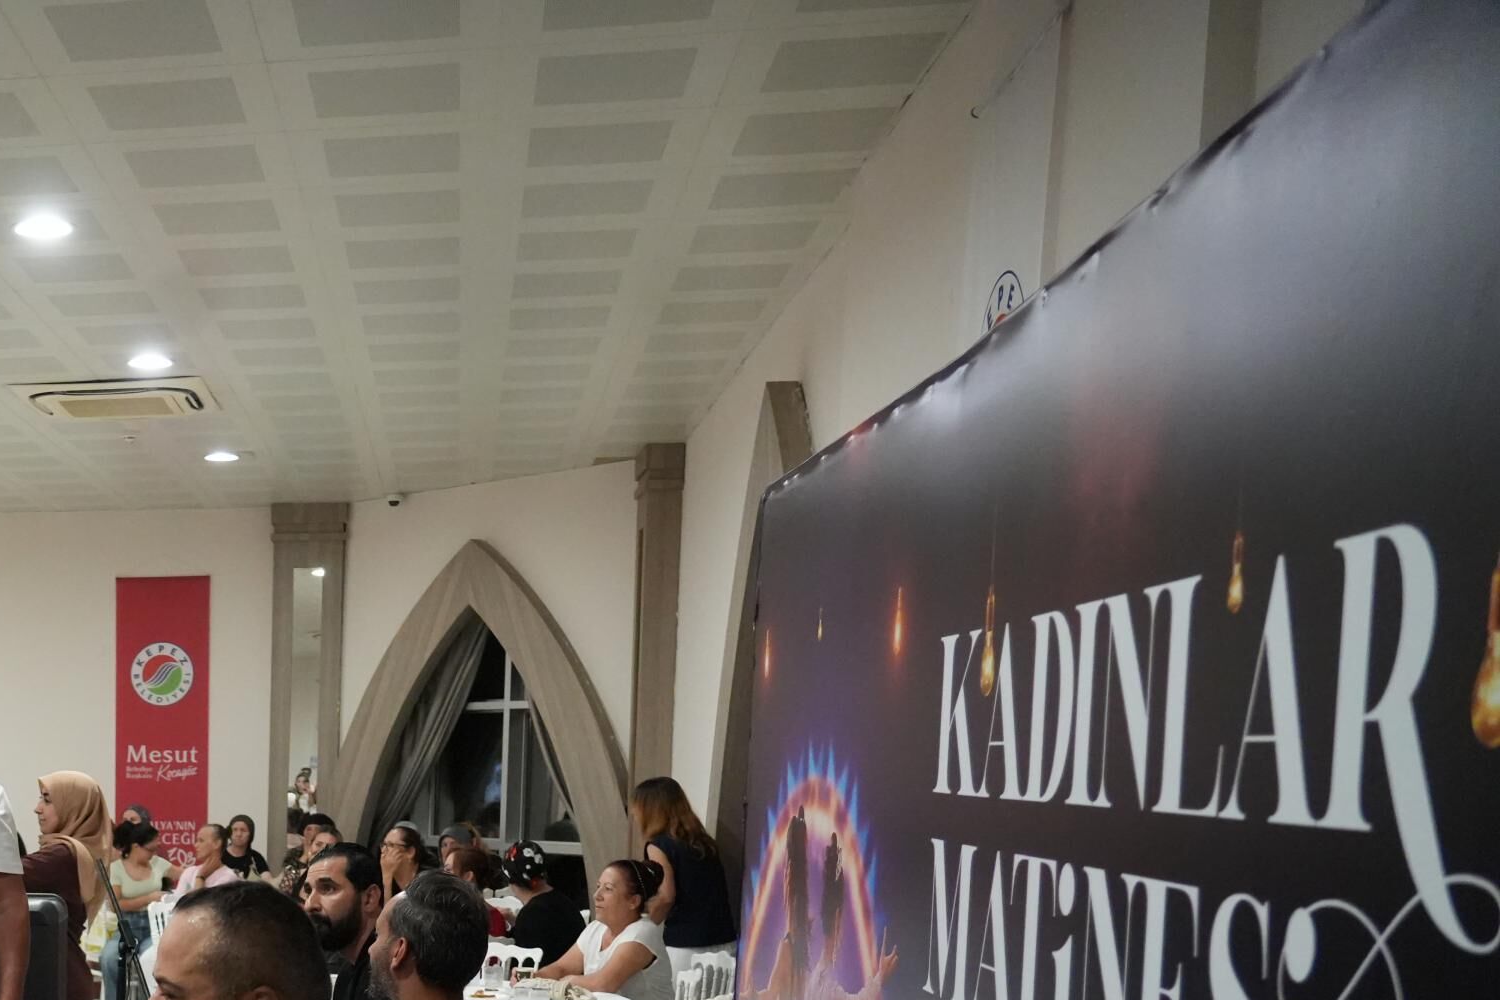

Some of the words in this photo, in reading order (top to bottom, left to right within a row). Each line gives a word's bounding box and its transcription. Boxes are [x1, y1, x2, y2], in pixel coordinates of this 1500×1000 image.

[987, 283, 1016, 332] EPE
[136, 644, 188, 666] KEPEZ
[126, 744, 198, 763] Mesut
[932, 523, 1499, 954] KADINLAR
